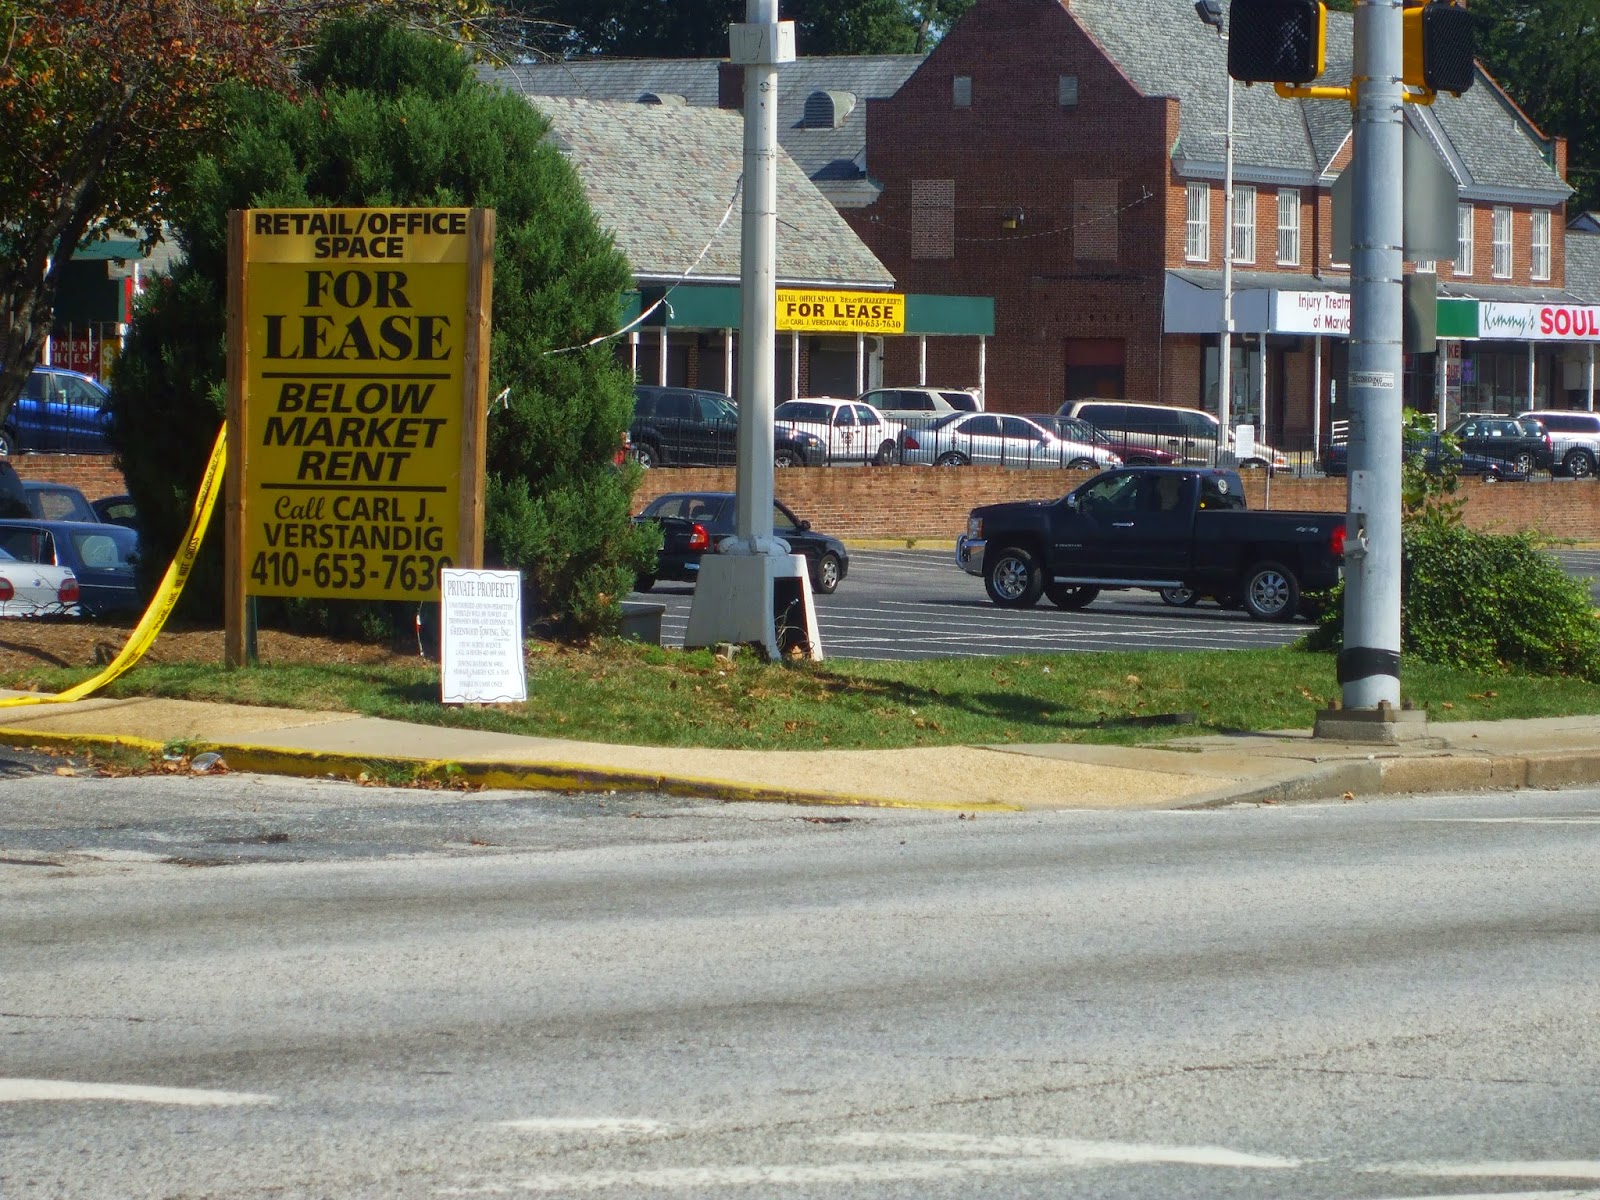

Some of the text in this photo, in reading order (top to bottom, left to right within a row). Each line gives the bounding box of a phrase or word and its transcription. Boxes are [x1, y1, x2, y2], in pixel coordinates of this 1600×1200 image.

[255, 213, 466, 235] RETAIL/OFFICE
[315, 237, 403, 258] SPACE
[304, 270, 412, 308] FOR
[787, 303, 893, 320] FOR LEASE
[1299, 294, 1321, 311] Injury
[812, 319, 848, 327] VERSTANDIG
[851, 319, 901, 329] 410-653-7630
[1313, 314, 1321, 328] of
[1484, 302, 1599, 336] Kimmy's SOUL
[263, 315, 451, 361] LEASE
[277, 383, 436, 415] BELOW
[263, 416, 447, 448] MARKET
[297, 451, 411, 482] RENT
[274, 495, 434, 523] Call CARL J.
[263, 522, 443, 551] VERSTANDIG
[185, 537, 200, 559] CROSS
[447, 580, 515, 598] PRIVATE PROPERTY
[450, 626, 478, 636] GREENWOOD
[501, 626, 511, 637] INC.
